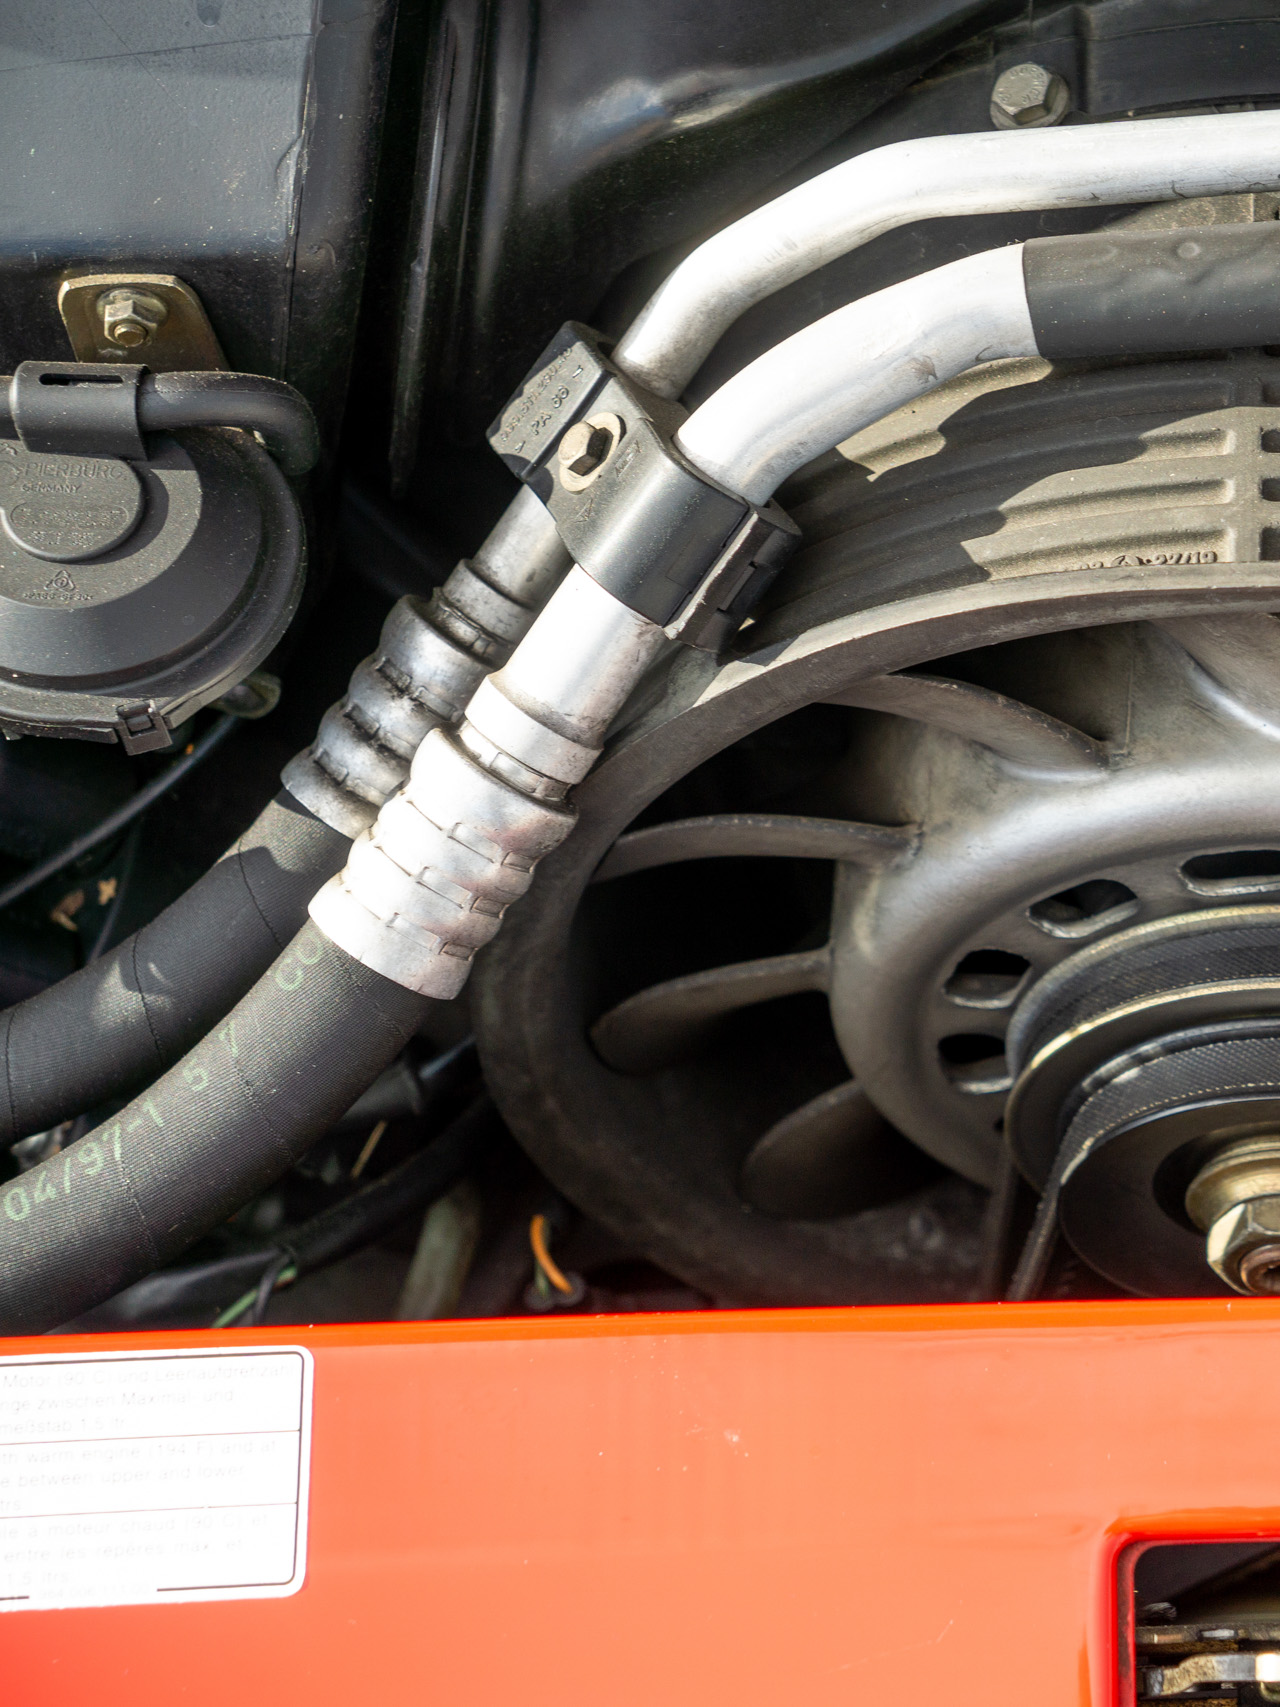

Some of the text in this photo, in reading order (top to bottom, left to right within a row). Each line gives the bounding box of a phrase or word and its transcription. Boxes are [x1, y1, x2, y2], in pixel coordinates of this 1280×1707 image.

[23, 461, 123, 479] PIERBURG
[21, 483, 82, 493] GERMANY
[3, 1373, 50, 1388] Motor
